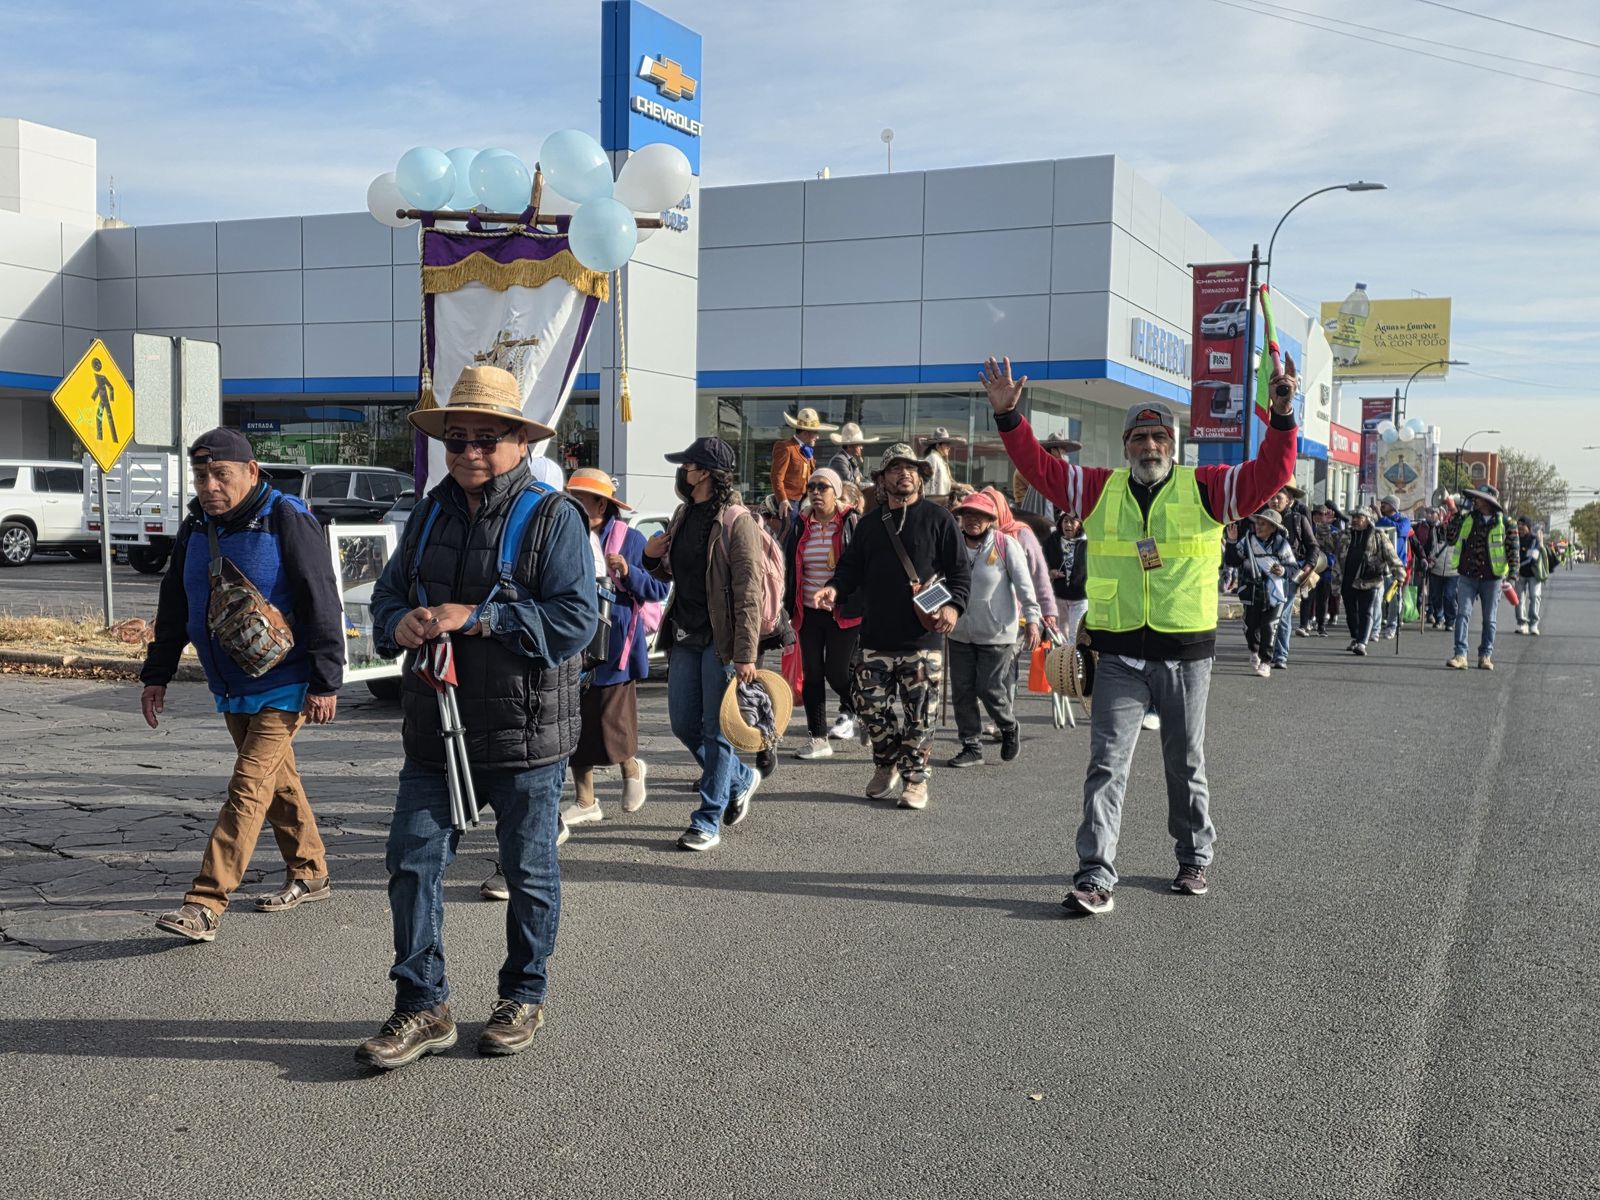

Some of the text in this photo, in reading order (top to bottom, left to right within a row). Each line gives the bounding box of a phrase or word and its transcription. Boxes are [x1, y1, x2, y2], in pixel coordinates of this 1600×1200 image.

[632, 95, 704, 137] CHEVROLET
[1407, 322, 1437, 331] Lourdes
[1387, 333, 1418, 341] SABOR
[1416, 339, 1447, 347] TODO
